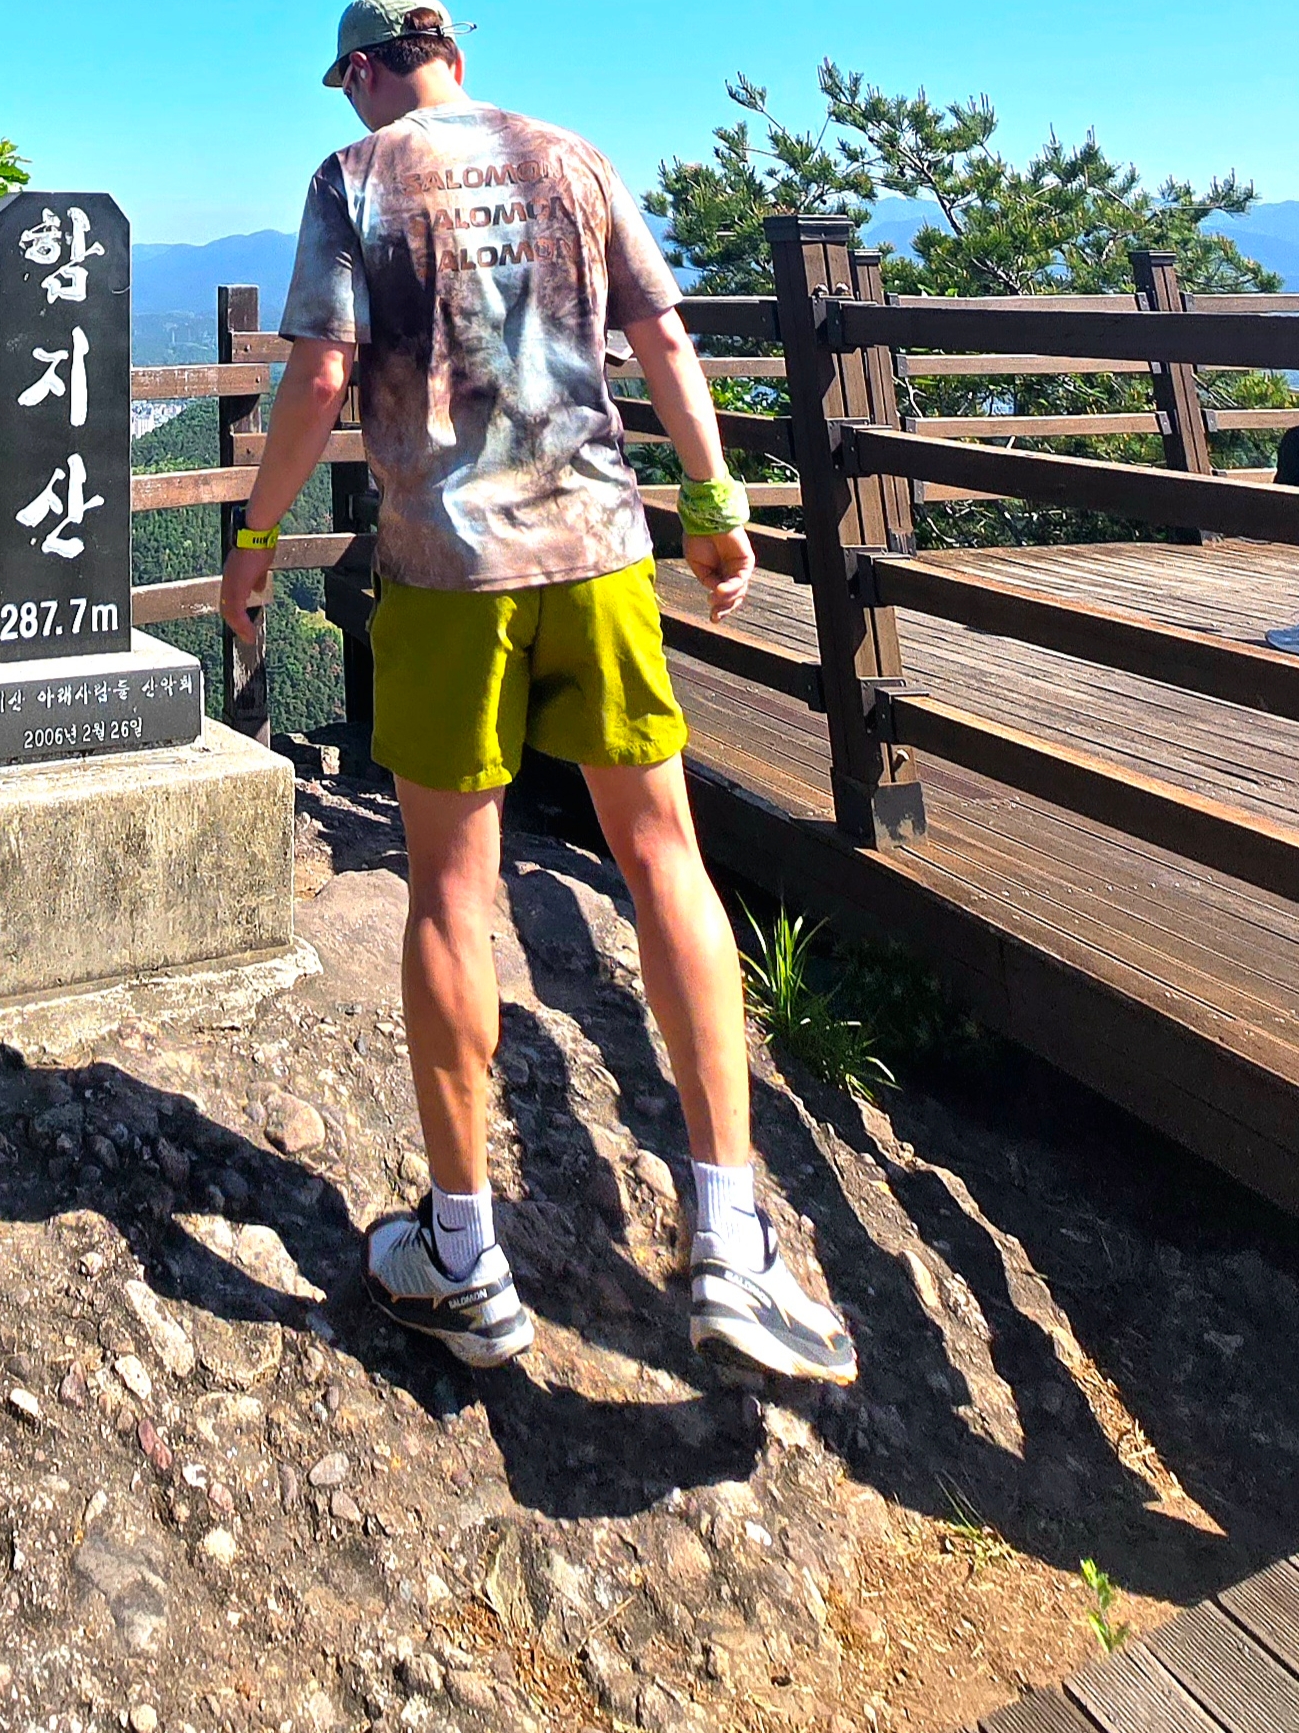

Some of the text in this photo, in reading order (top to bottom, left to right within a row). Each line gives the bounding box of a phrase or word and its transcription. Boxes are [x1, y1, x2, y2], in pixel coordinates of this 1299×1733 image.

[16, 206, 106, 559] 함지산
[0, 598, 119, 642] 287.7m
[36, 679, 130, 709] 아래사람들
[141, 673, 194, 698] 산악회
[23, 716, 143, 749] 2006년 2월 26일
